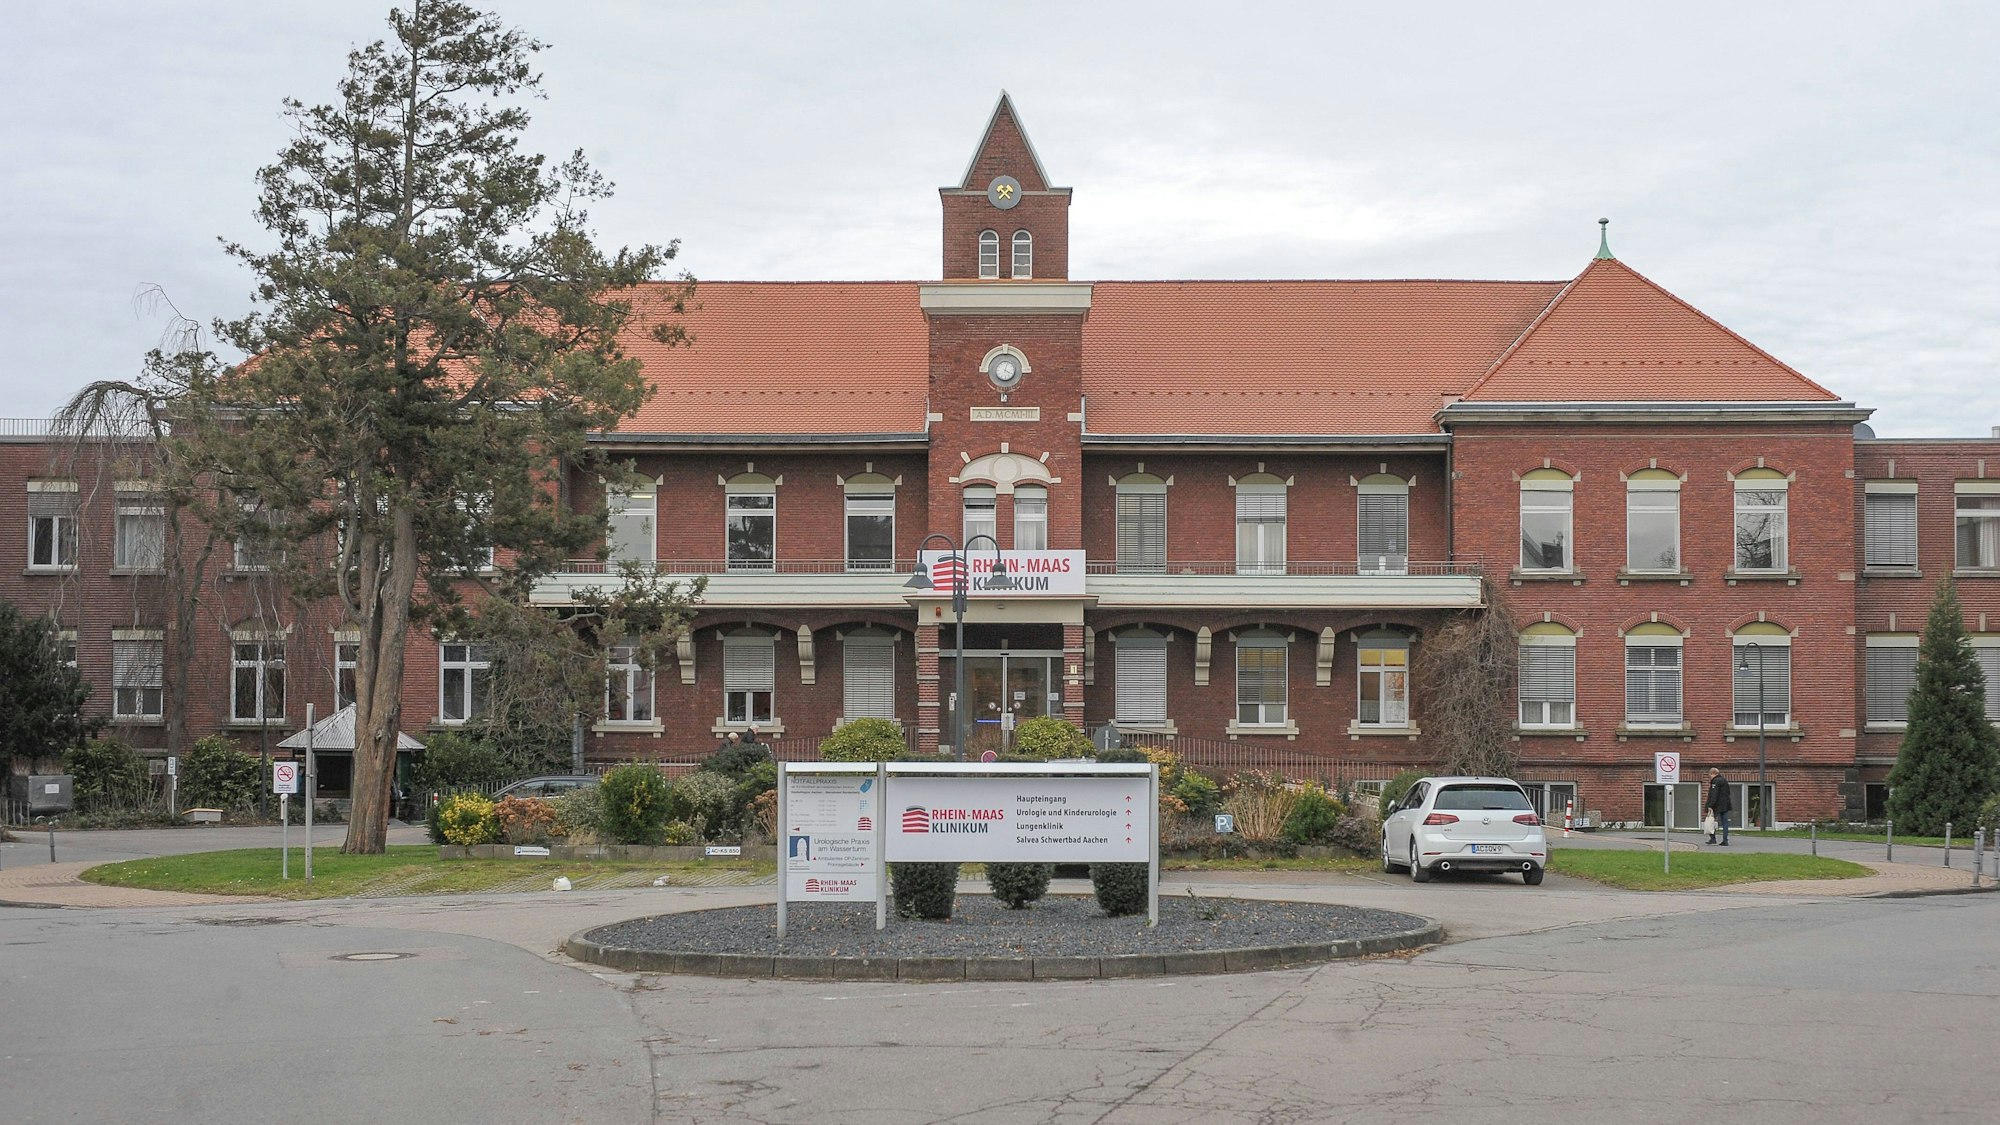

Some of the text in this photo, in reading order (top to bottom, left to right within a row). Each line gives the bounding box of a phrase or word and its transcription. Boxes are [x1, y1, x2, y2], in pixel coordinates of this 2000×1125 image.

[973, 558, 1070, 573] RHIN-MAAS
[1016, 795, 1067, 804] Haupteingang
[932, 809, 1004, 820] RHEIN-MAAS
[1016, 809, 1047, 818] Urologie
[1063, 809, 1117, 818] Kinderurologie
[932, 822, 988, 834] KLINIKUM
[1016, 822, 1064, 831] Lungenklinik
[814, 838, 850, 846] Urologische
[1016, 836, 1108, 844] Salvea Schwertbad Aachen
